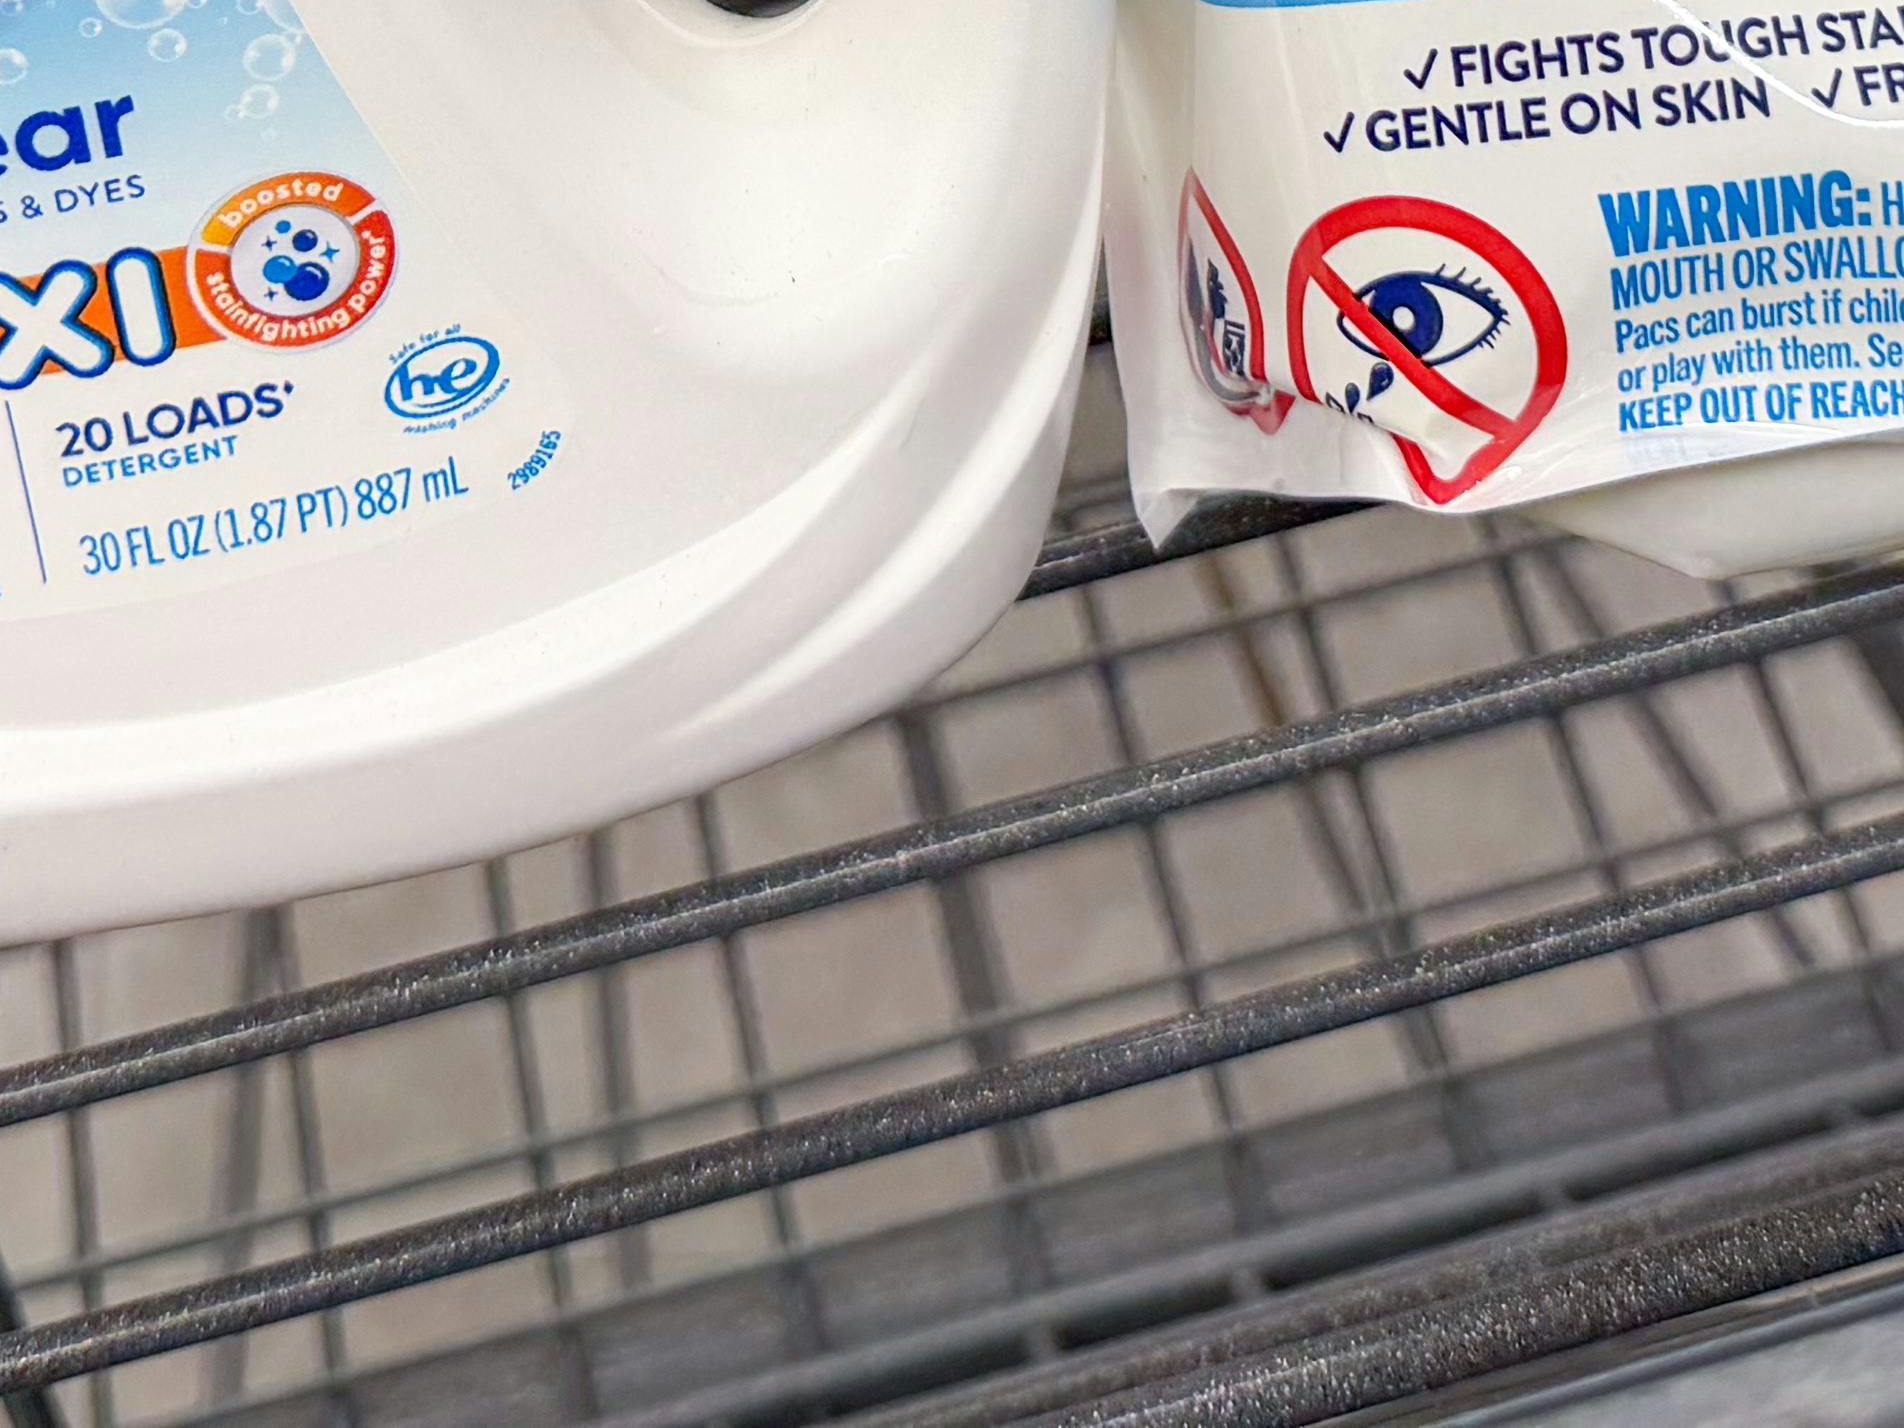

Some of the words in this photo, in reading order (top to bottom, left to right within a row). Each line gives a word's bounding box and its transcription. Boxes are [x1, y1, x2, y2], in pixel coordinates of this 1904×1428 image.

[1450, 31, 1625, 89] FIGHTS
[1630, 14, 1810, 71] TOUGH
[1364, 94, 1552, 154] GENTLE
[1560, 88, 1643, 136] ON
[1652, 74, 1772, 129] SKIN
[19, 193, 44, 219] &
[55, 173, 147, 213] DYES
[218, 177, 345, 229] boosted
[1597, 168, 1871, 258] WARNING:
[205, 271, 351, 343] stainfighting
[1609, 256, 1727, 310] MOUTH
[1732, 246, 1777, 291] OR
[1614, 317, 1681, 354] Pacs
[1686, 307, 1734, 340] can
[1740, 290, 1817, 331] burst
[1821, 288, 1844, 324] if
[1616, 363, 1647, 393] or
[1652, 353, 1706, 395] play
[1711, 335, 1775, 376] with
[1779, 335, 1862, 372] them.
[55, 417, 114, 459] 20
[1617, 391, 1693, 432] KEEP
[1697, 384, 1758, 425] OUT
[1763, 380, 1805, 421] OF
[62, 435, 239, 488] DETERGENT
[79, 531, 123, 577] 30
[127, 523, 166, 569] FL
[170, 512, 212, 562] OZ
[214, 498, 288, 555] (1.87
[296, 484, 351, 535] PT)
[355, 467, 413, 522] 887
[422, 455, 470, 503] mL
